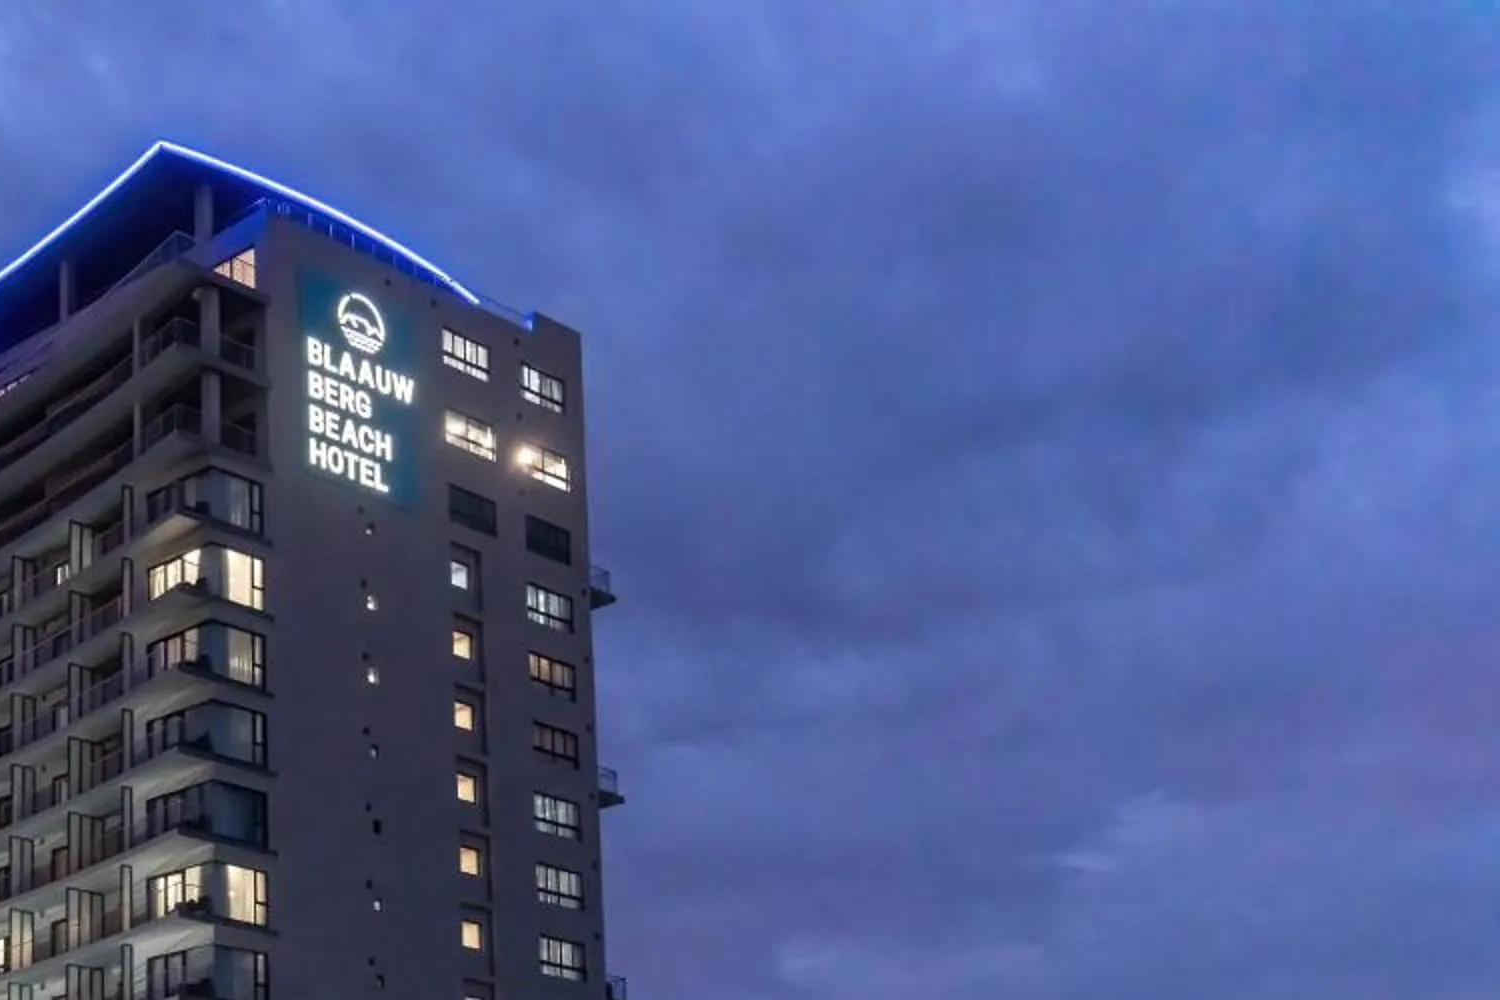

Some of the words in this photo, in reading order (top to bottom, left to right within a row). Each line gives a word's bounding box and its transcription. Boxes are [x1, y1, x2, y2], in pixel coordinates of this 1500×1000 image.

[306, 336, 415, 405] BLAAUW
[307, 370, 373, 419] BERG
[308, 404, 393, 462] BEACH
[308, 437, 389, 493] HOTEL
